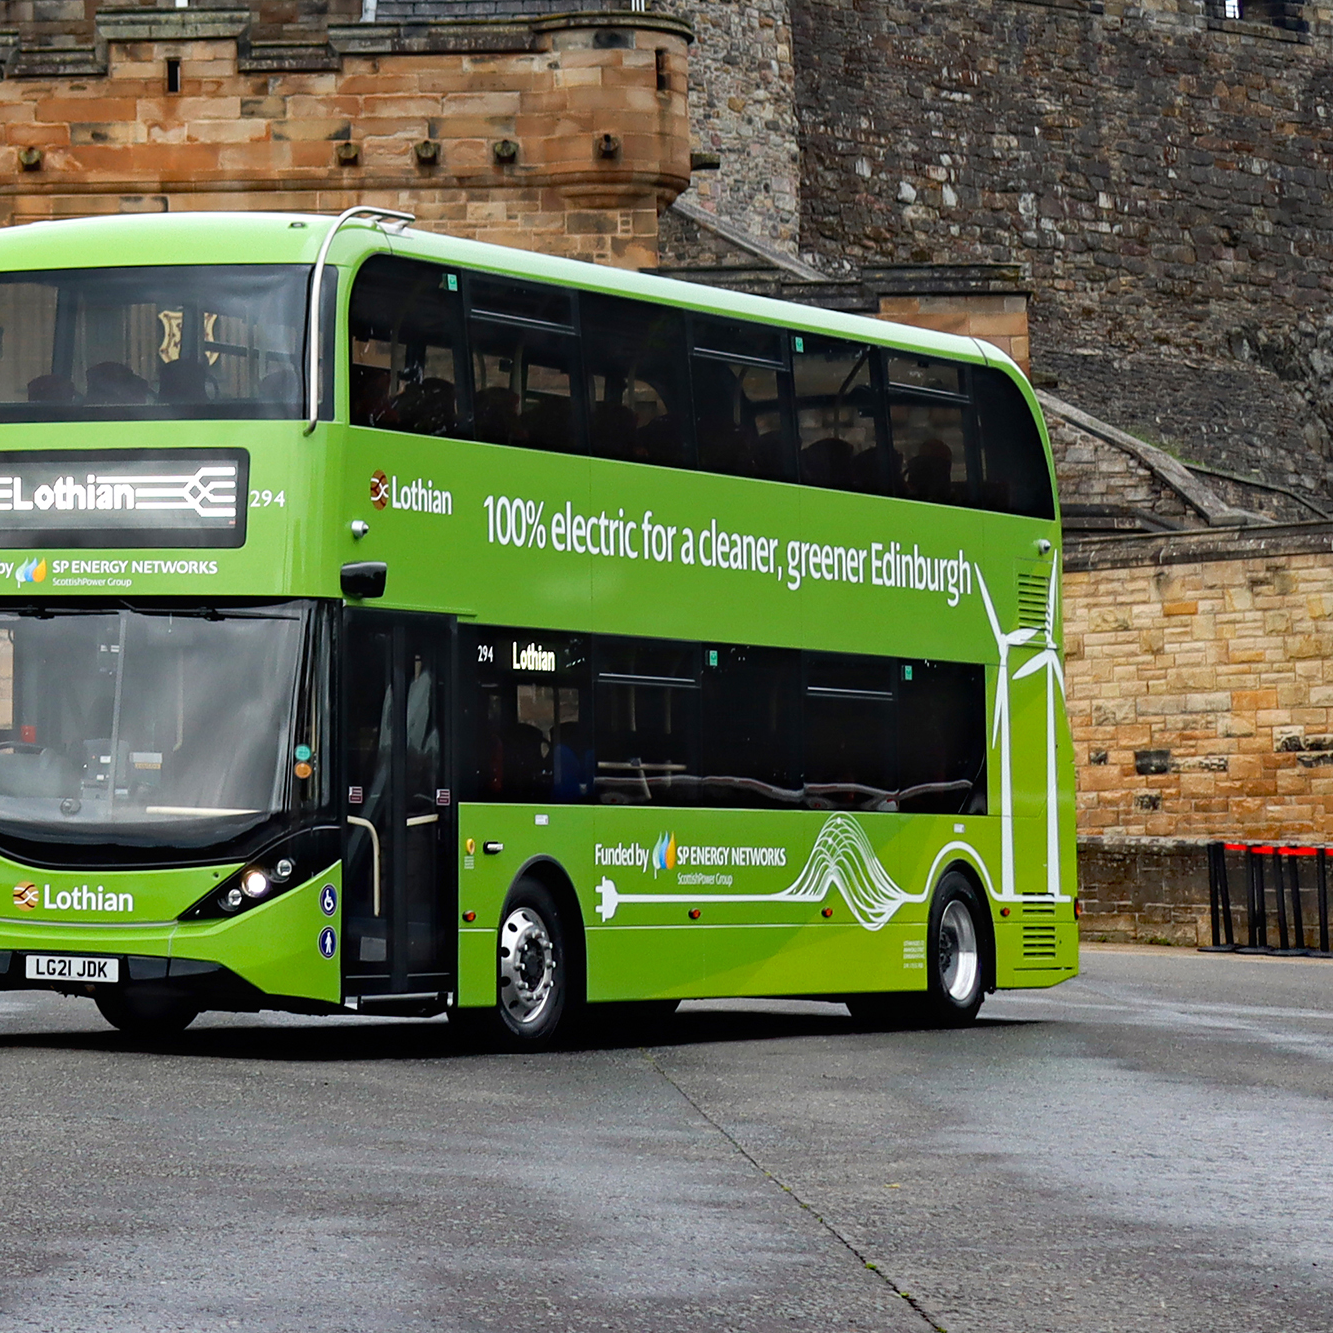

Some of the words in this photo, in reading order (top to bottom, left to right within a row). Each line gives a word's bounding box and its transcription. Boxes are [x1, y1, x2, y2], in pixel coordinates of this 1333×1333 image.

[11, 473, 136, 511] Lothian
[249, 489, 286, 508] 294
[391, 475, 453, 515] Lothian
[482, 494, 547, 549] 100%
[551, 502, 639, 559] electric
[642, 511, 677, 563] for
[680, 526, 695, 566] a
[699, 520, 783, 582] cleaner,
[786, 541, 867, 591] greener
[870, 542, 973, 607] Edinburgh
[52, 559, 70, 574] SP
[71, 560, 129, 574] ENERGY
[131, 560, 219, 575] NETWORKS
[52, 577, 107, 587] ScottishPower
[107, 577, 133, 588] Group
[477, 644, 494, 663] 294
[512, 641, 556, 672] Lothian
[594, 842, 635, 866] Funded
[635, 843, 650, 874] by
[676, 845, 690, 865] SP
[690, 846, 730, 866] ENERGY
[731, 847, 787, 867] NETWORKS
[677, 872, 716, 885] ScottishPower
[716, 873, 733, 888] Group
[43, 883, 134, 912] Lothian
[35, 958, 73, 977] LG21
[77, 960, 108, 979] JDK
